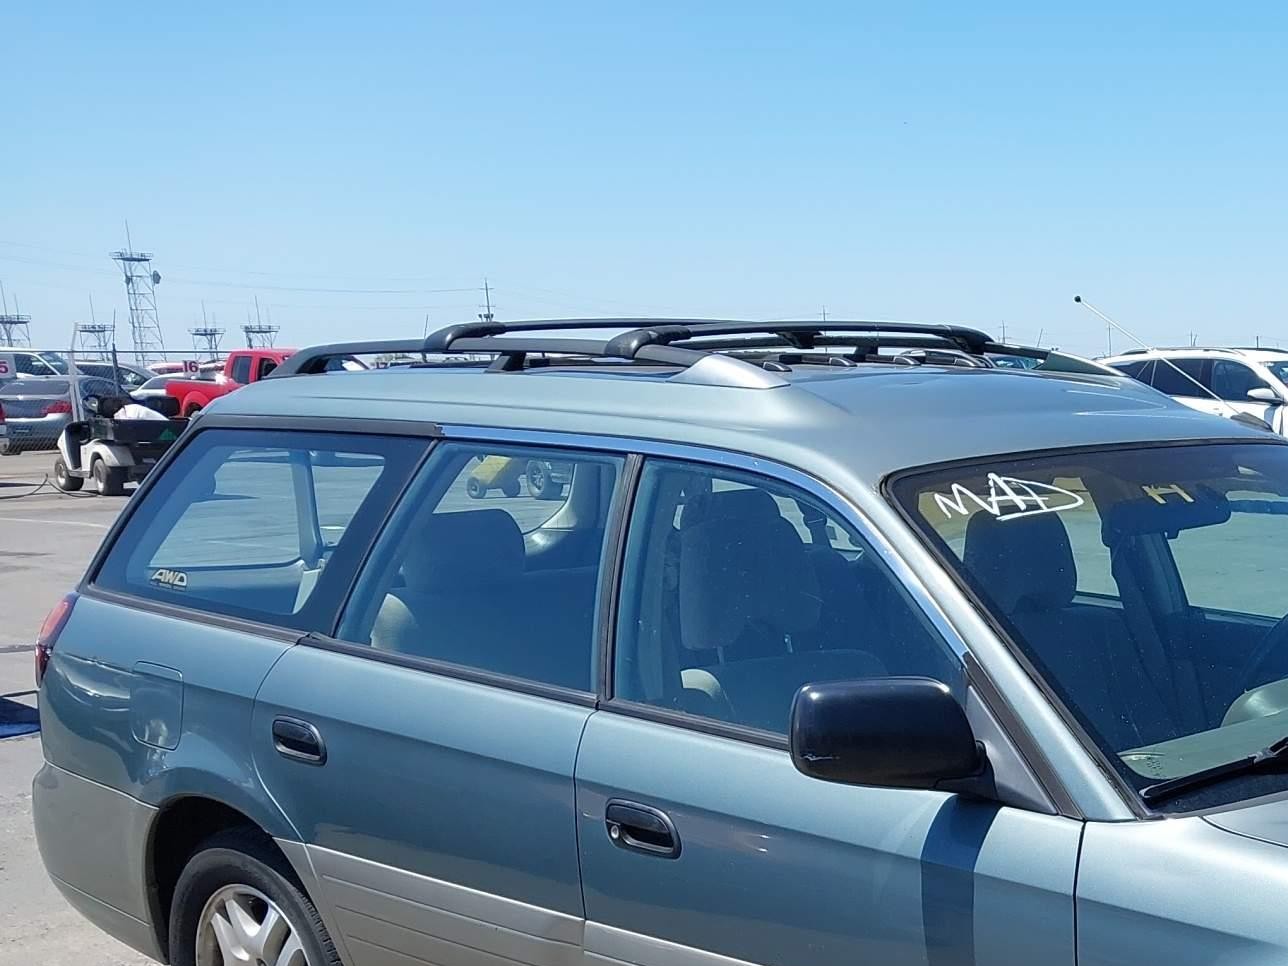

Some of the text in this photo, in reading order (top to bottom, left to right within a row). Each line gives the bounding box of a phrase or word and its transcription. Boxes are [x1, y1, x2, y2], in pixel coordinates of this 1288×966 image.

[183, 360, 199, 373] 16
[933, 472, 1085, 522] MAD
[151, 568, 187, 587] AWD
